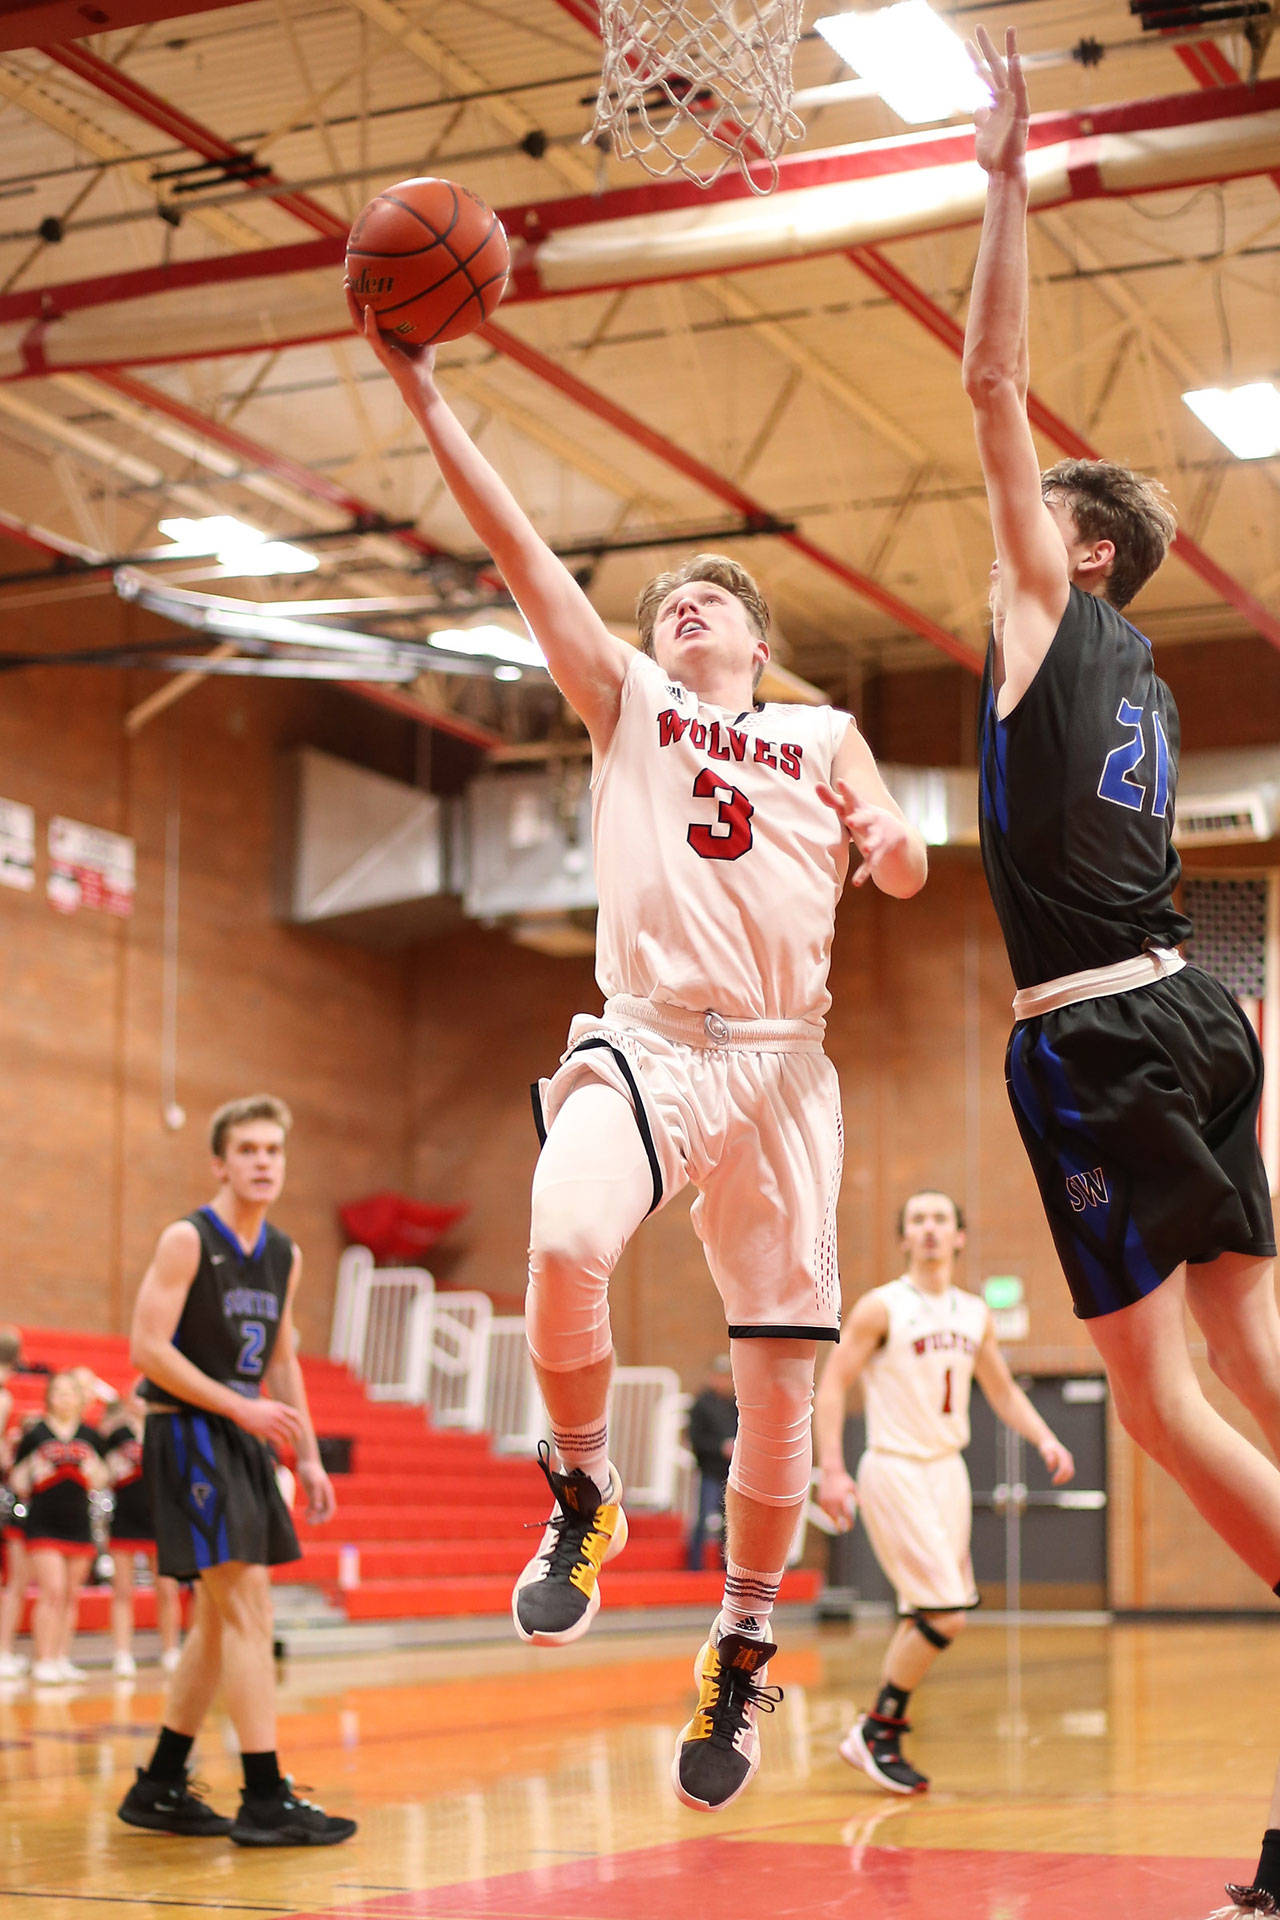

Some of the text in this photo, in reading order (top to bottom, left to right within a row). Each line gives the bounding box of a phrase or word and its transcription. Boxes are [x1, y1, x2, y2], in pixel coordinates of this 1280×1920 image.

[657, 708, 803, 781] WOLVES
[1097, 697, 1169, 818] 21
[687, 767, 754, 861] 3
[1066, 1167, 1109, 1212] SW
[237, 1320, 266, 1376] 2
[942, 1368, 952, 1414] 1
[735, 1622, 760, 1632] adidas
